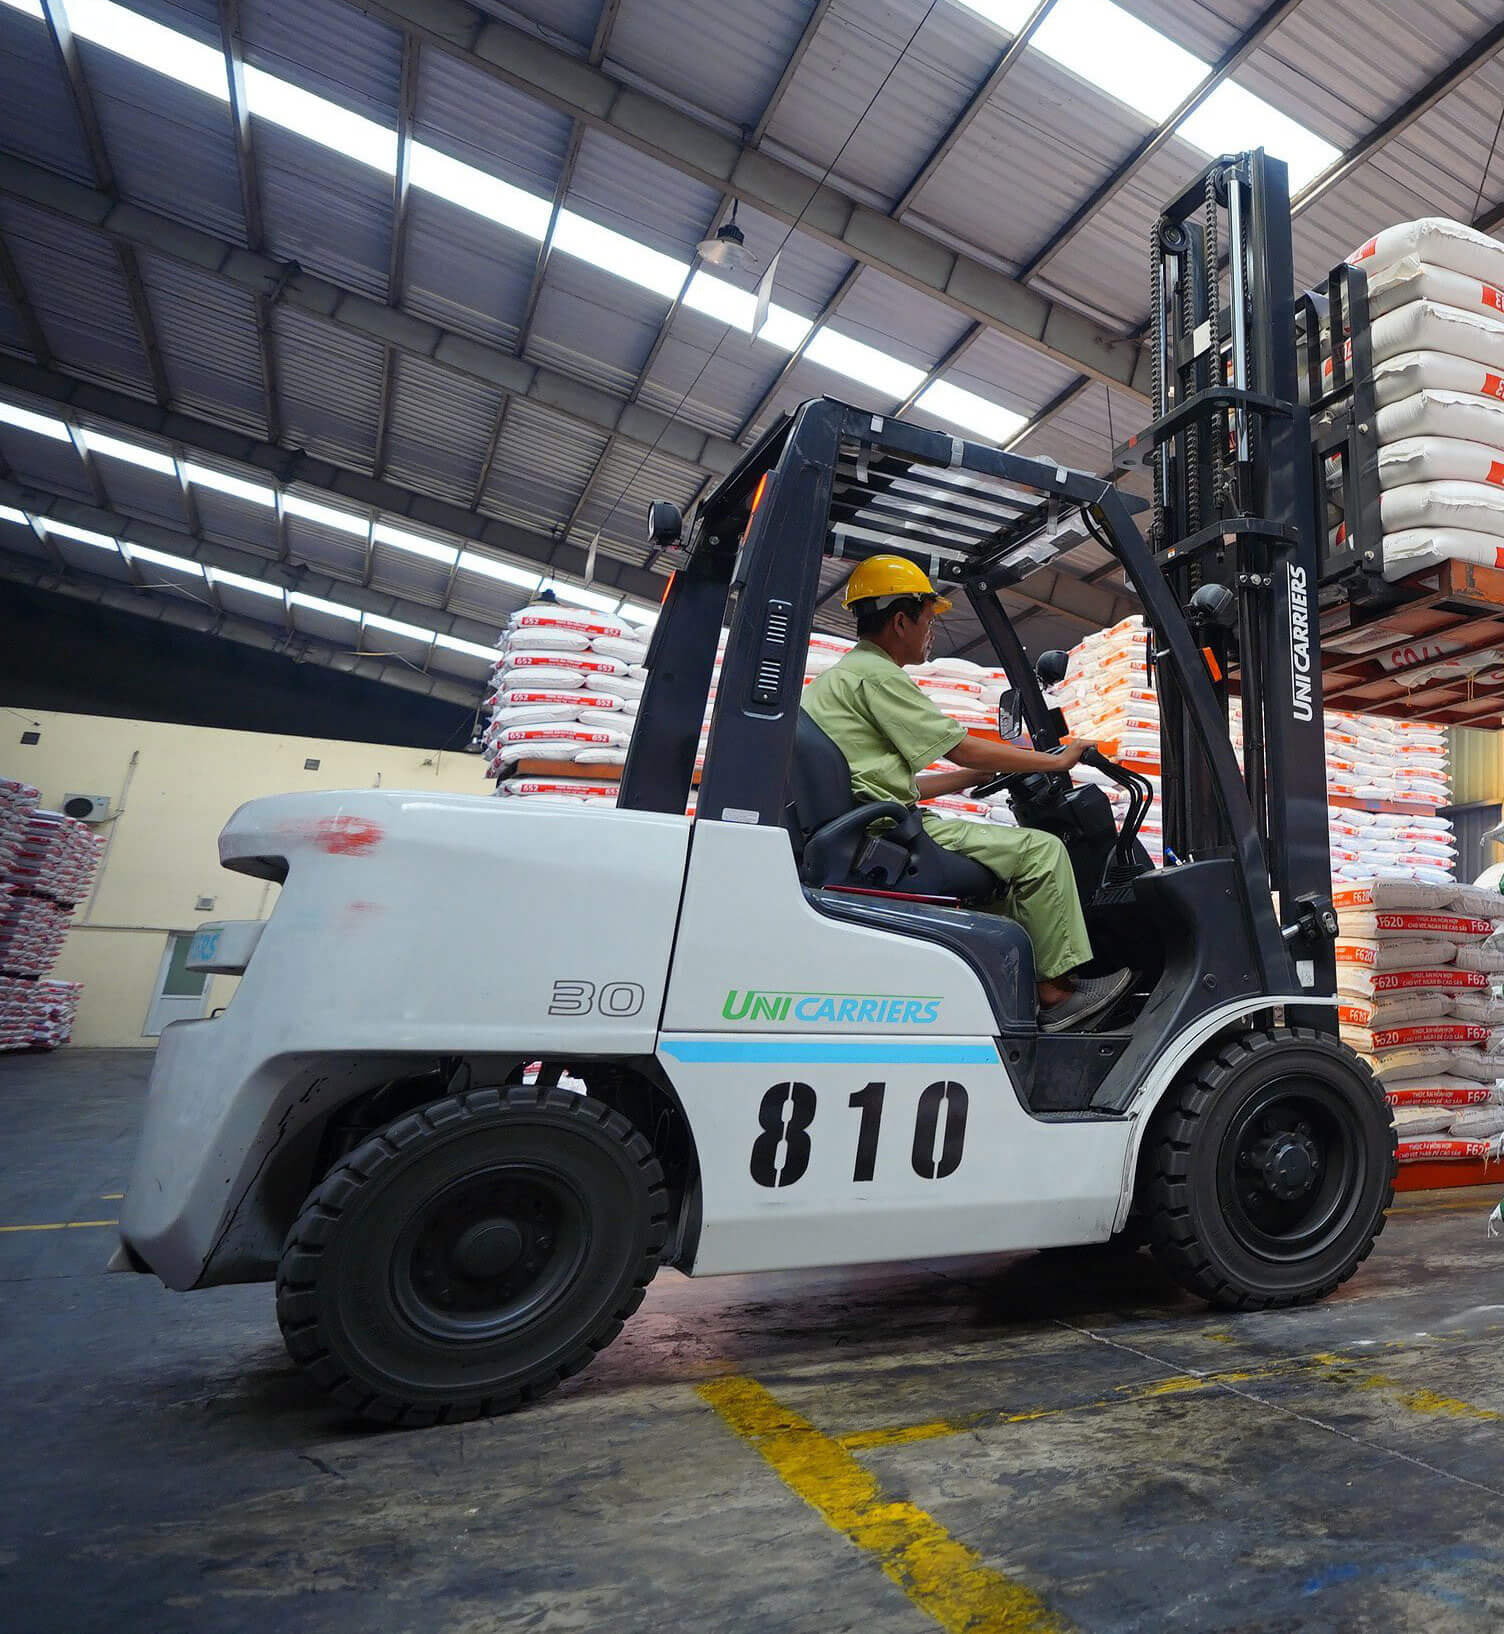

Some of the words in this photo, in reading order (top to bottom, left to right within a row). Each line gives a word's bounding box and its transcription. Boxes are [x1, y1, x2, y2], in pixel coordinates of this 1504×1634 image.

[1287, 562, 1312, 722] UNICARRIERS
[548, 980, 645, 1017] 30
[749, 1081, 970, 1188] 810
